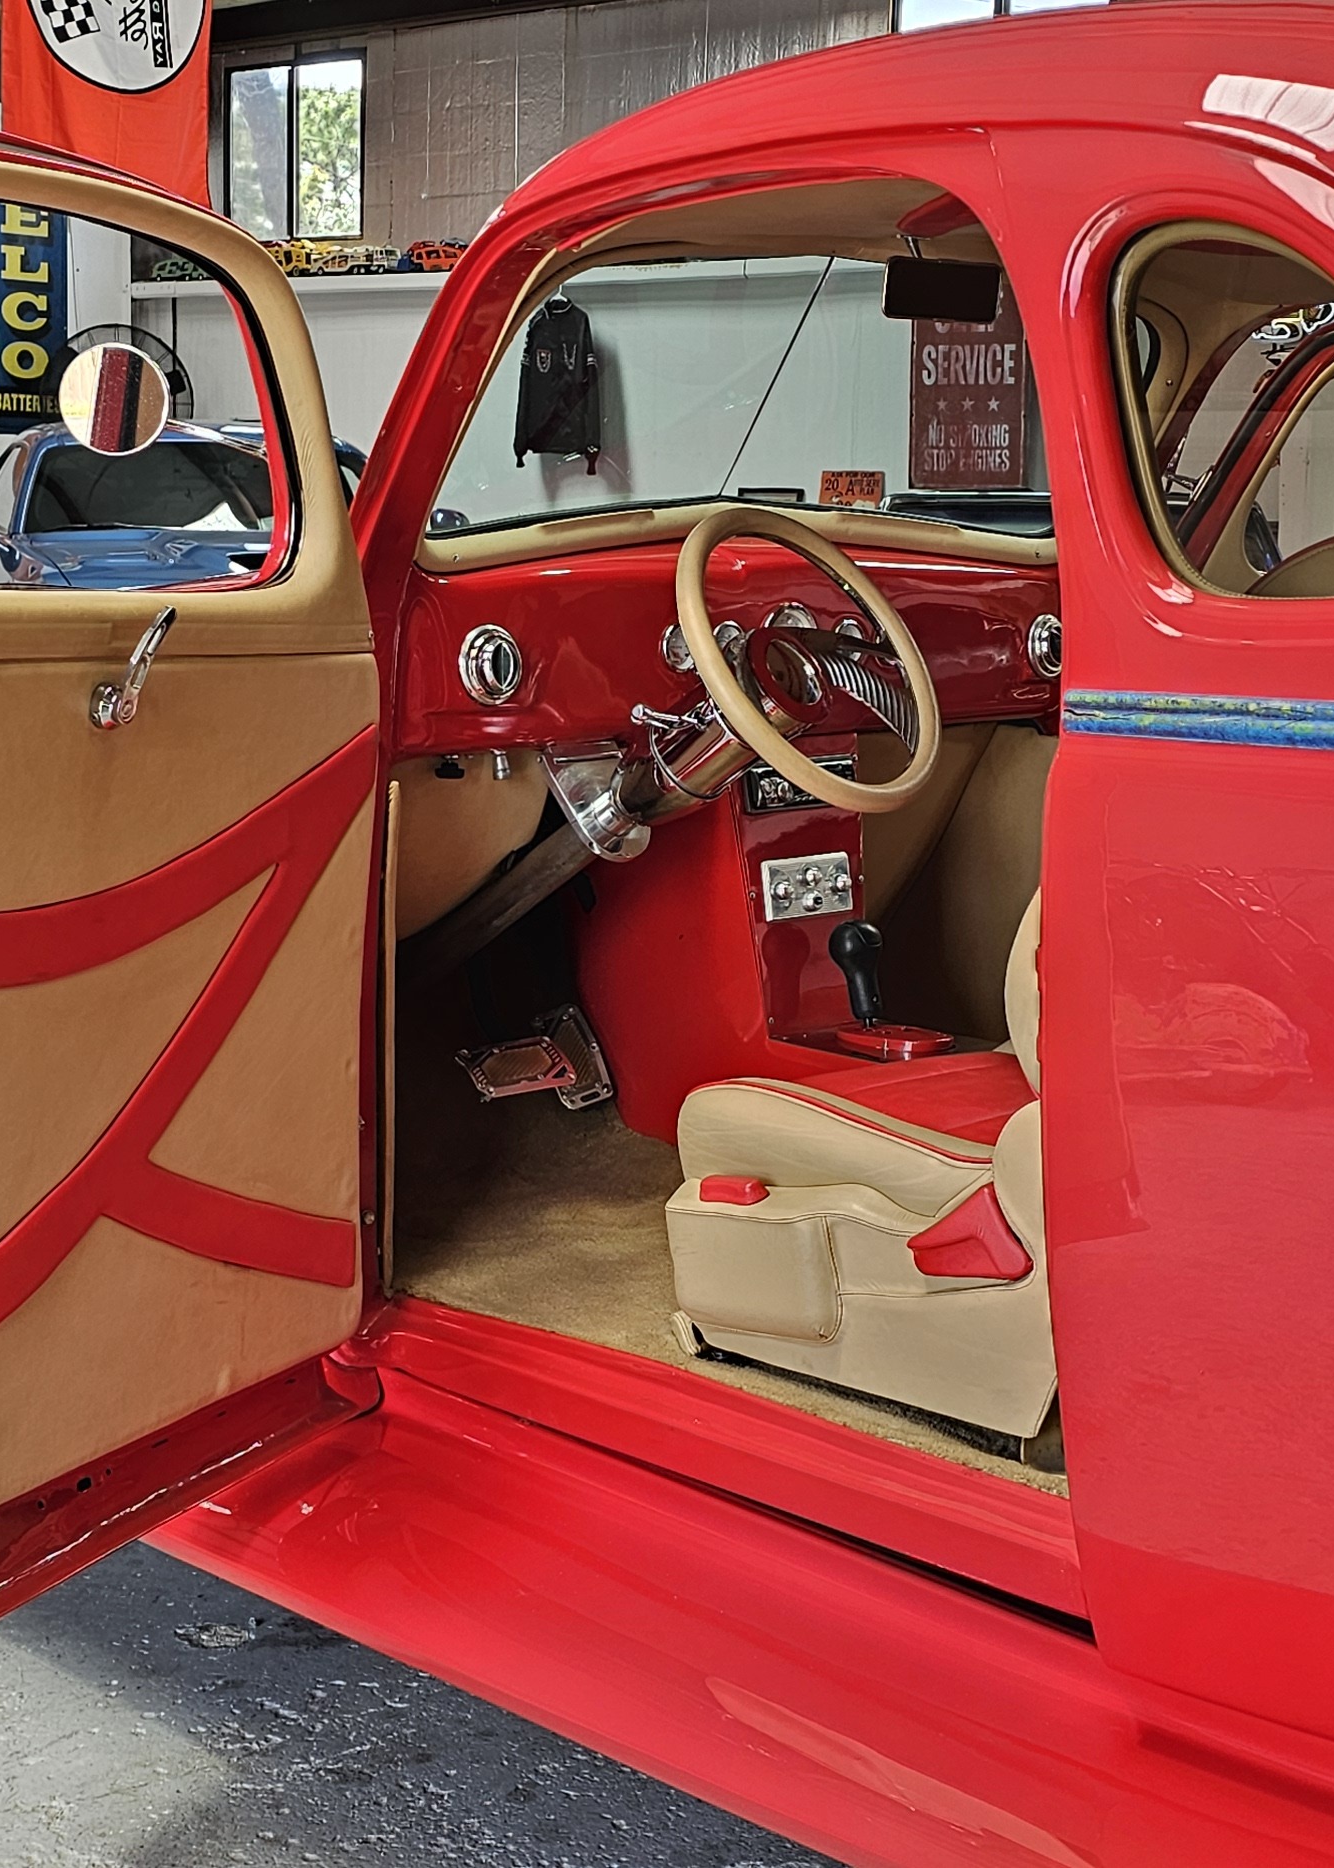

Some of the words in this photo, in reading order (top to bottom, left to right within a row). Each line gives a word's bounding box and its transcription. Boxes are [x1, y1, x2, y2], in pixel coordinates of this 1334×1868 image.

[921, 343, 1017, 386] SERVICE
[928, 421, 945, 447] NO
[824, 478, 839, 491] 20
